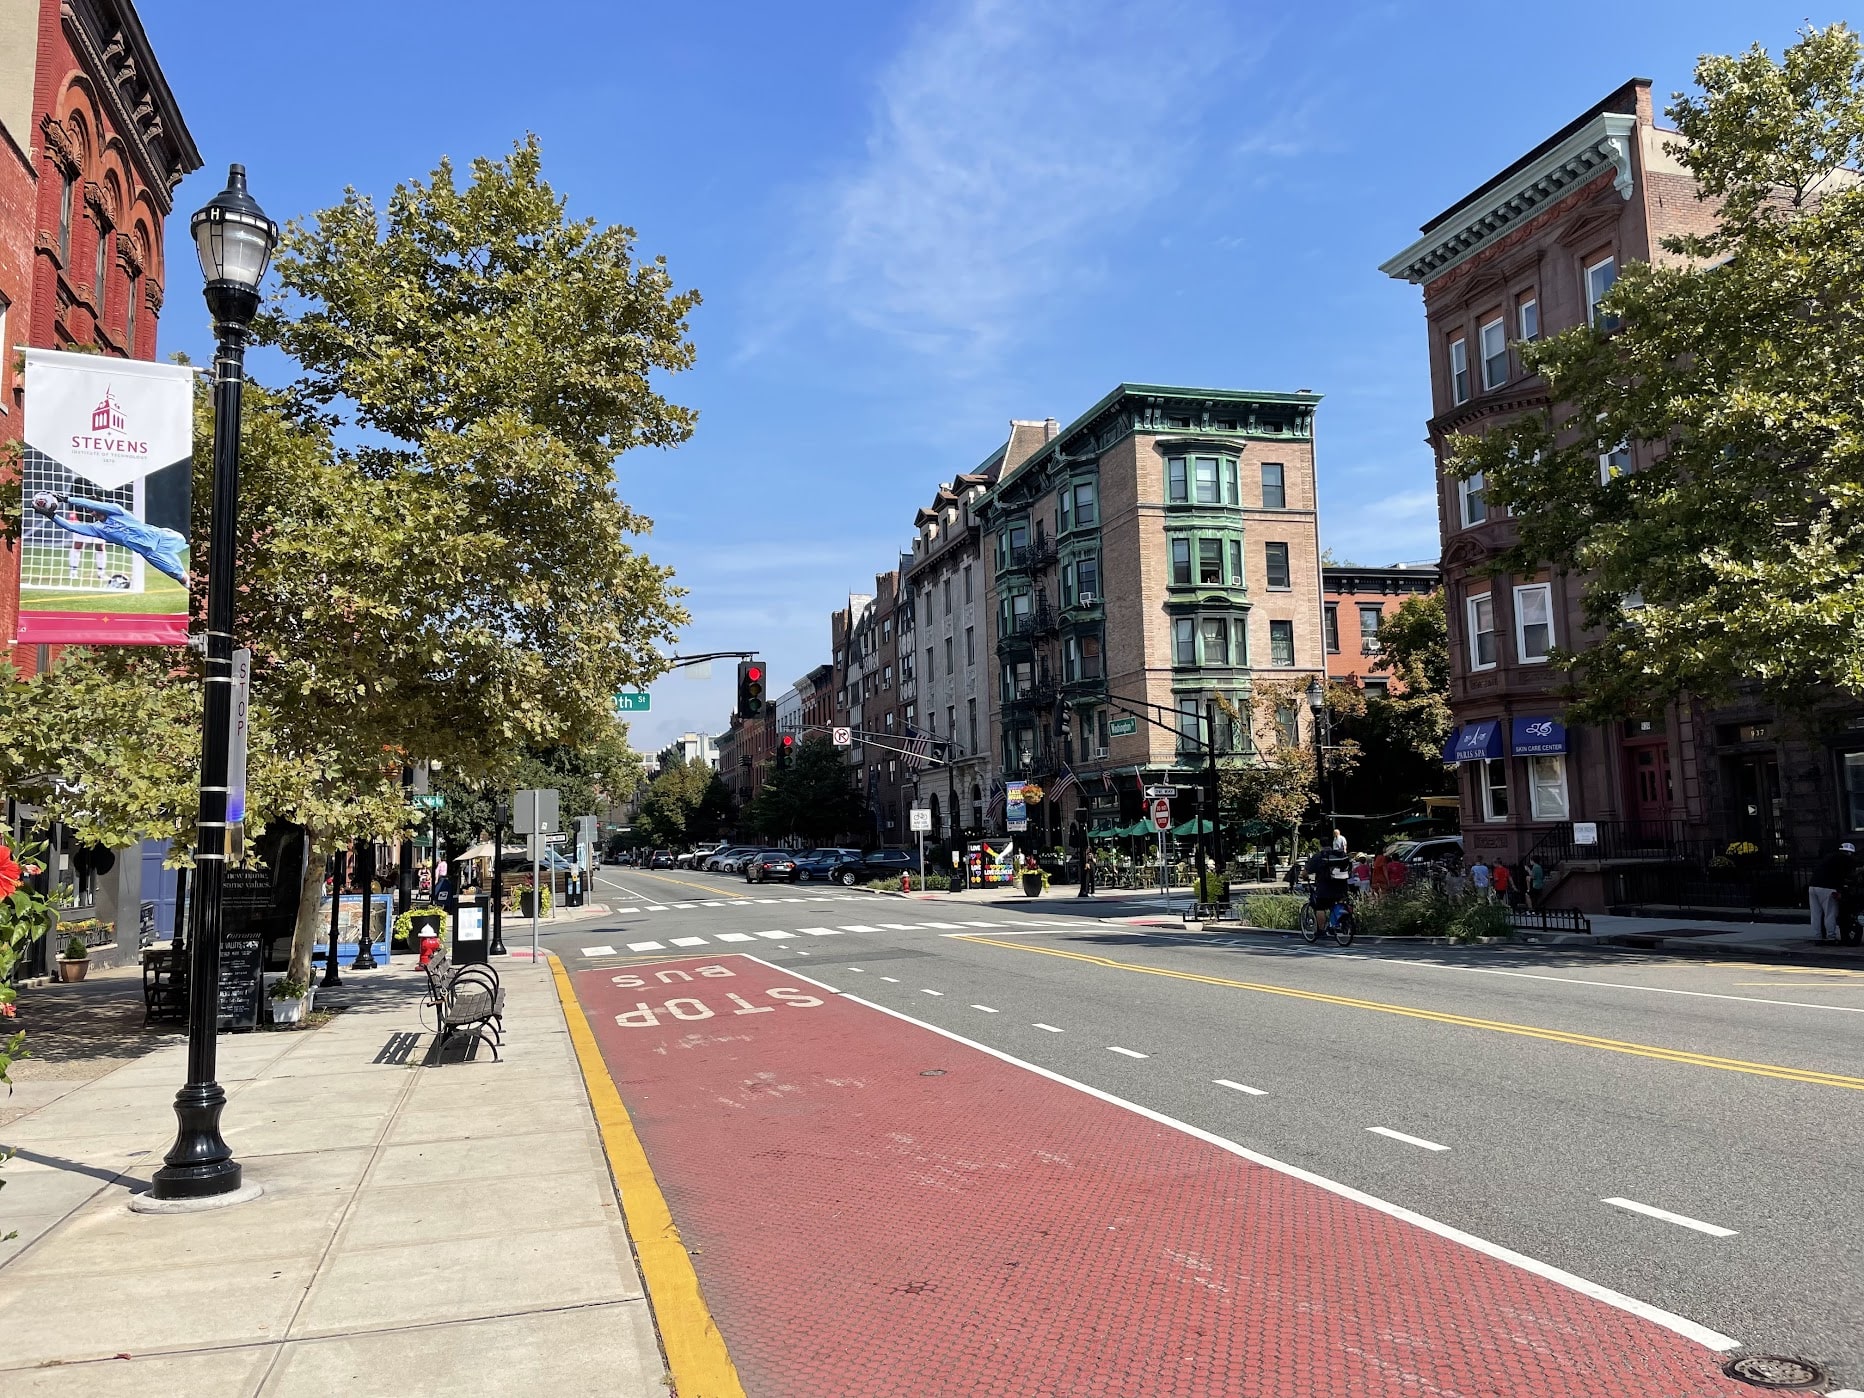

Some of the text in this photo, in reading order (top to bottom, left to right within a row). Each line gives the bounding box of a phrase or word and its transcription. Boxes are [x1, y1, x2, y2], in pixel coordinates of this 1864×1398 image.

[211, 207, 219, 220] H
[271, 223, 277, 237] H
[72, 436, 148, 454] STEVENS
[237, 663, 247, 737] STOP
[637, 695, 646, 703] St
[1542, 743, 1562, 751] CENTER
[1456, 749, 1485, 760] PARIS SPA
[611, 964, 737, 988] BUS
[614, 987, 825, 1027] STOP
